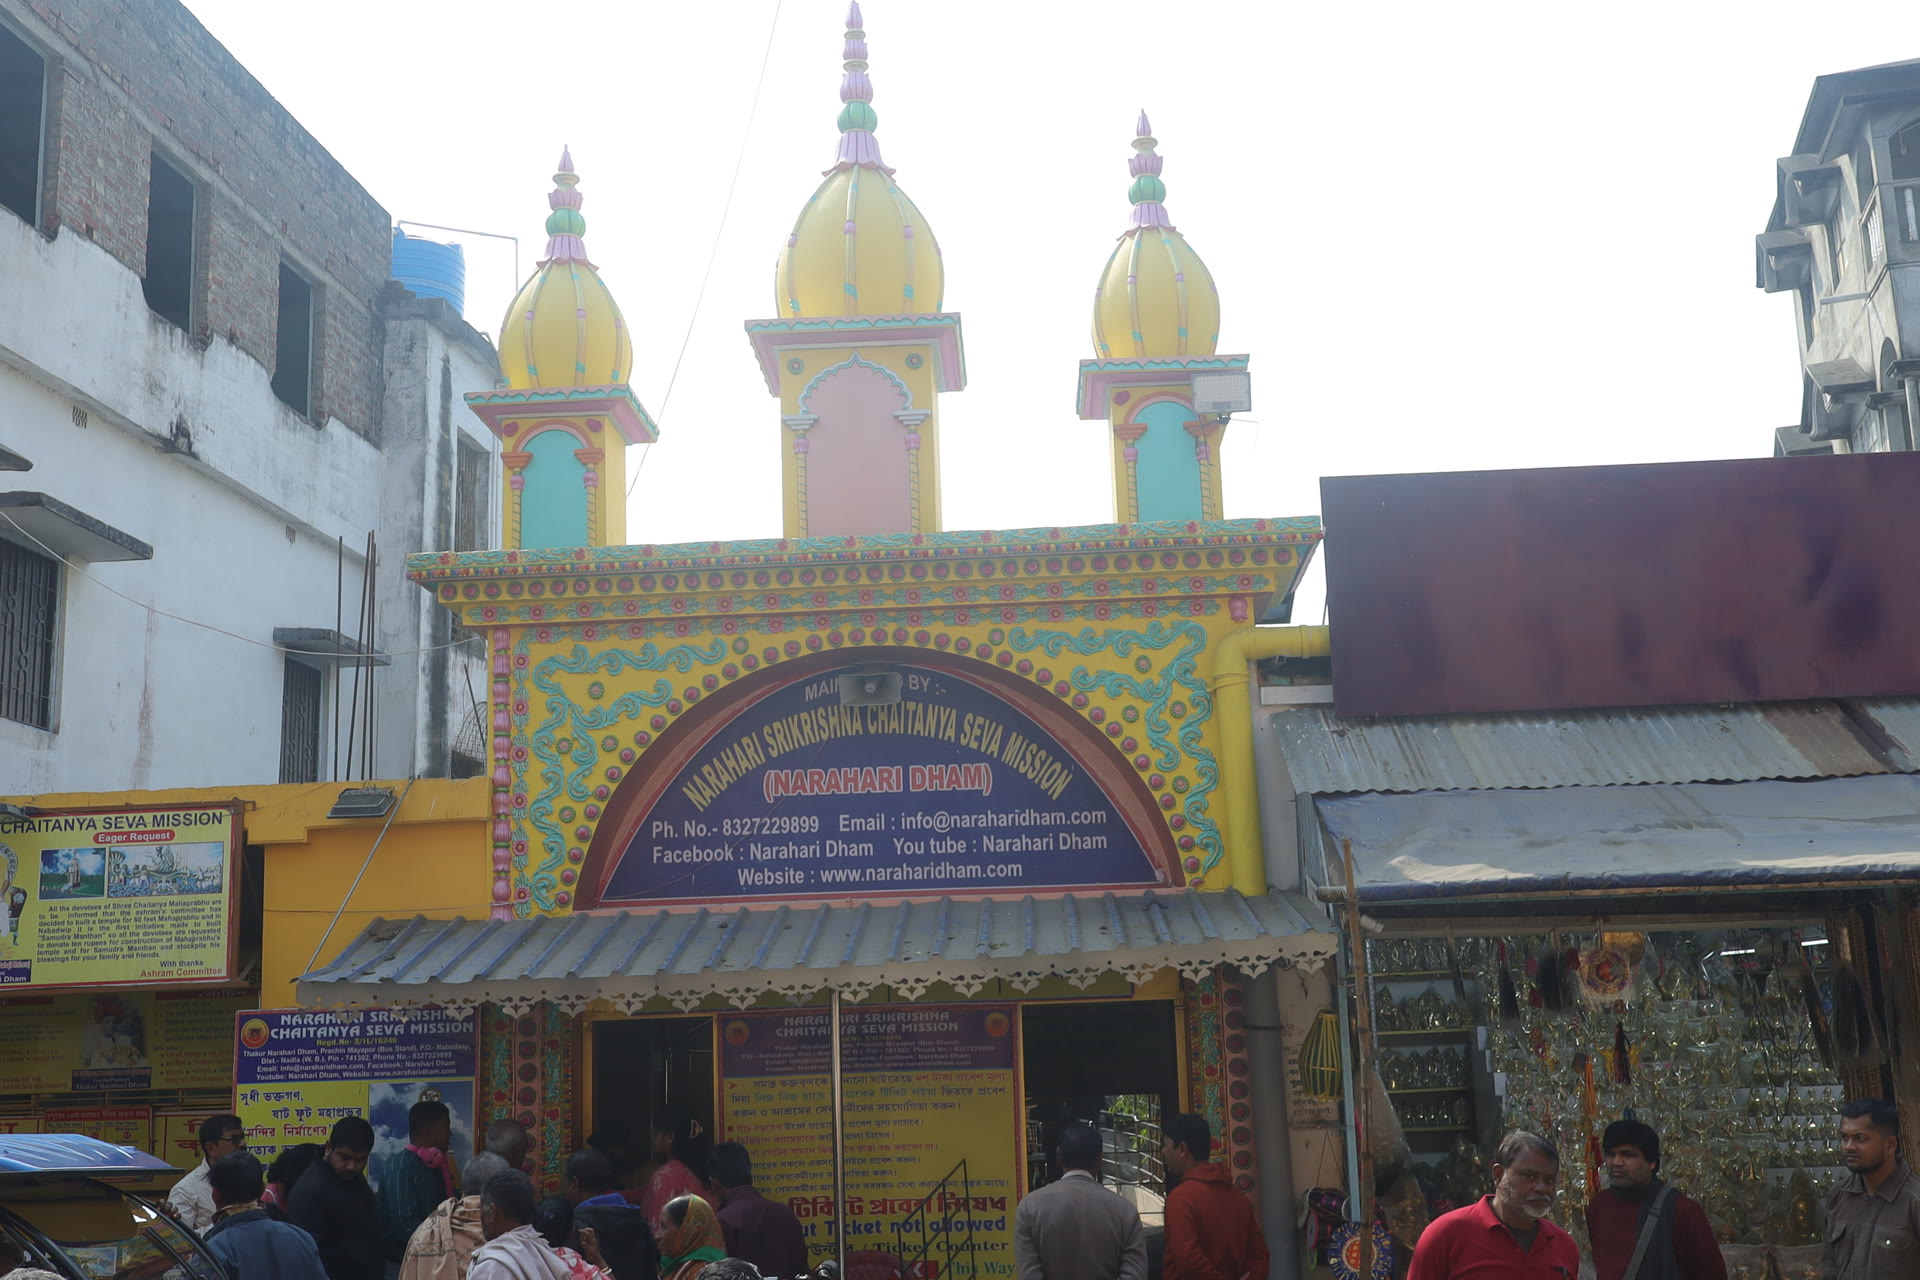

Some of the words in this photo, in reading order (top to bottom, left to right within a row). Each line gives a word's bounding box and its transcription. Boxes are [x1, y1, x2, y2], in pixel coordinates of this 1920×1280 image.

[909, 674, 931, 692] BY
[682, 732, 766, 812] NARAHARI
[763, 704, 863, 758] SRIKRISHNA
[867, 701, 957, 742] CHAITANYA
[960, 713, 1003, 758] SEVA
[1001, 731, 1073, 801] MISSION
[764, 766, 903, 803] (NARAHARI
[909, 762, 993, 796] DHAM)
[1, 818, 97, 834] CHAITANYA
[102, 815, 147, 829] SEVA
[152, 812, 222, 827] MISSION
[652, 820, 679, 839] Ph.
[722, 816, 819, 837] 8327229899
[839, 812, 885, 832] Email
[901, 808, 1107, 833] info@naraharidham.com
[99, 833, 127, 843] Eager
[130, 832, 170, 841] Request
[652, 844, 734, 864] Facebook
[750, 841, 820, 861] Narahari
[825, 839, 874, 858] Dham
[892, 838, 925, 855] You
[930, 837, 967, 854] tube
[983, 834, 1053, 852] Narahari
[1059, 832, 1107, 851] Dham
[737, 867, 805, 887] Website
[820, 861, 1023, 885] www.naraharidham.com
[134, 901, 167, 909] Chaitanya
[169, 899, 209, 907] Mahaprabhu
[98, 917, 120, 925] temple
[158, 914, 199, 922] Mahaprabhu
[188, 927, 221, 935] requested
[84, 940, 106, 948] rupees
[121, 936, 163, 944] construction
[37, 948, 59, 956] temple
[99, 953, 119, 961] family
[140, 969, 174, 977] Ashram
[176, 967, 222, 976] Committee
[281, 1011, 364, 1025] NARAHI
[865, 1011, 950, 1023] SRIKRISHNA
[270, 1025, 361, 1040] CHAITANYA
[367, 1023, 404, 1036] SEVA
[411, 1021, 474, 1034] MISSION
[862, 1023, 896, 1033] SEVA
[902, 1022, 958, 1032] MISSION
[297, 1048, 319, 1056] Dham,
[347, 1046, 376, 1054] Mayapur
[377, 1045, 393, 1053] (Bus
[257, 1065, 279, 1073] Email:
[367, 1061, 403, 1069] Facebook:
[256, 1073, 286, 1081] Youtube:
[343, 1070, 372, 1078] Website:
[374, 1068, 456, 1076] www.naraharidham.com
[240, 1089, 260, 1106] সুধী
[271, 1106, 290, 1119] ষাট
[295, 1106, 312, 1122] ফুট
[891, 1219, 921, 1234] not
[984, 1261, 1016, 1277] Way
